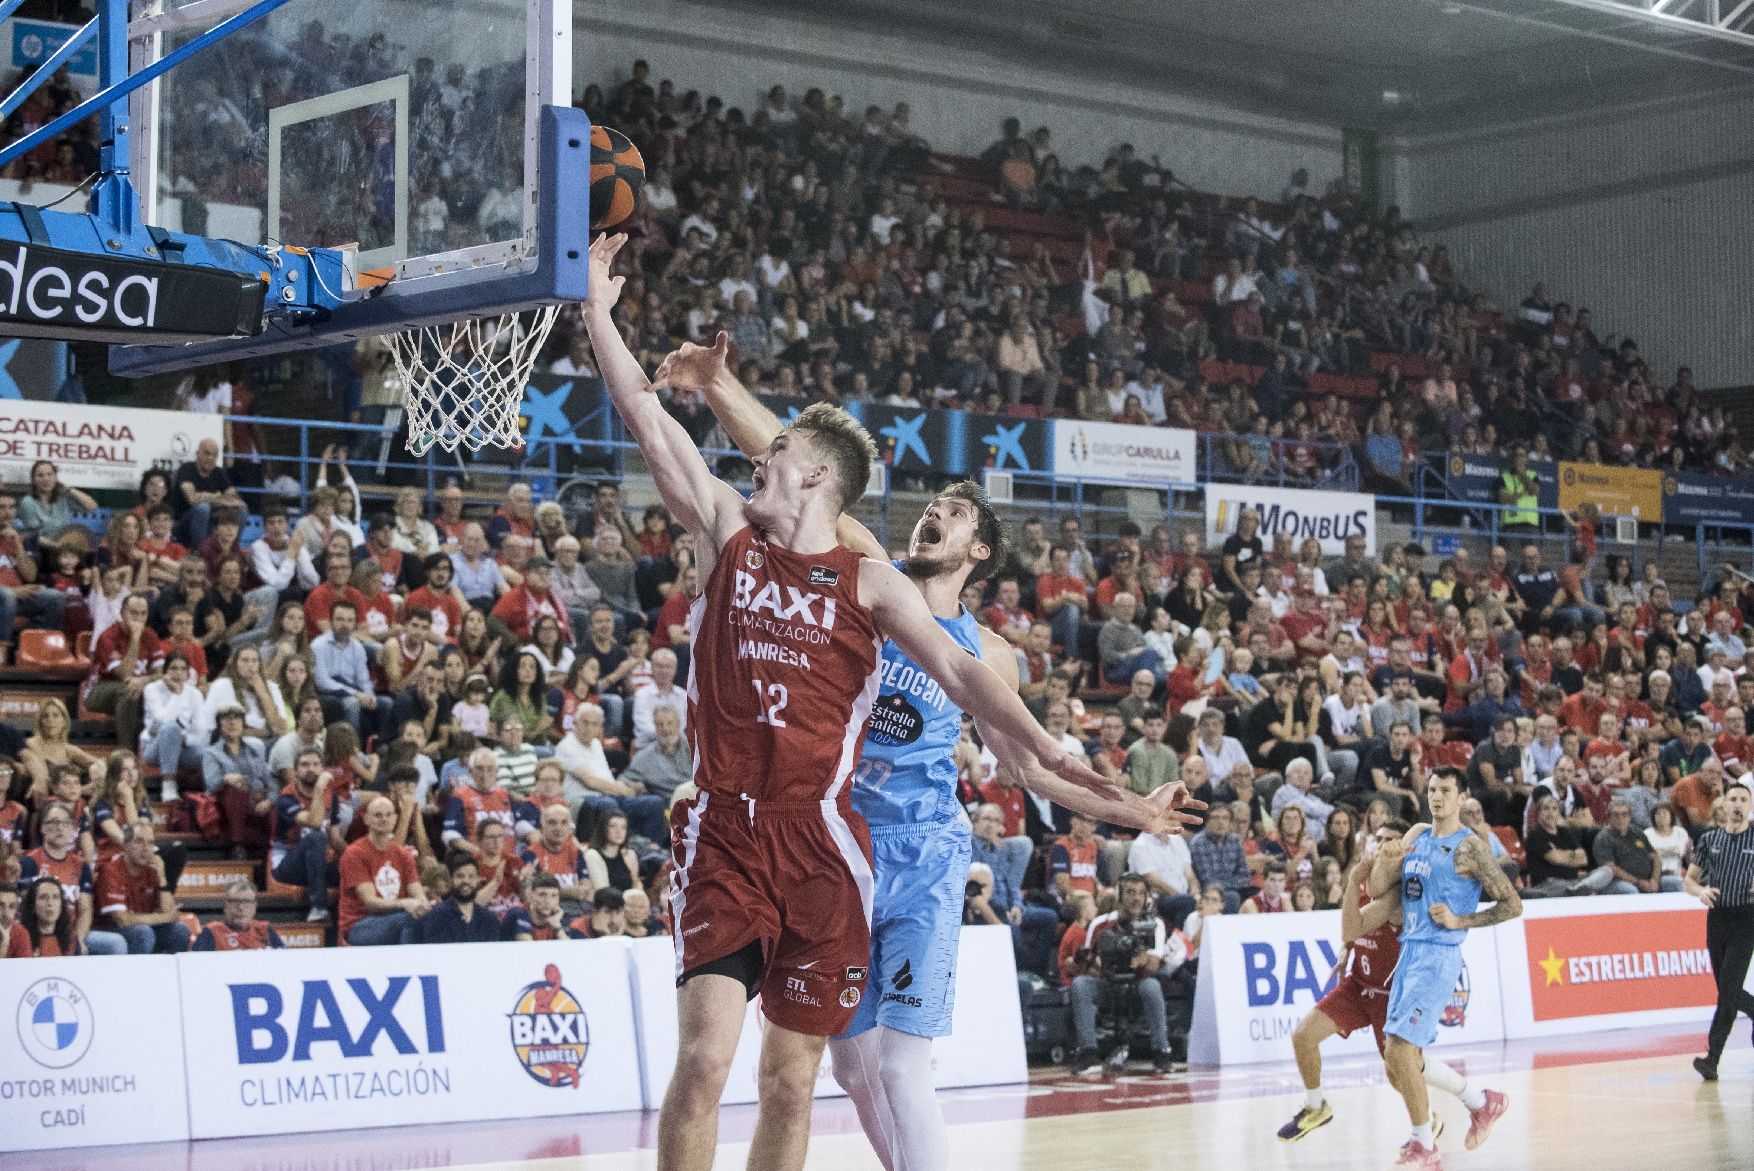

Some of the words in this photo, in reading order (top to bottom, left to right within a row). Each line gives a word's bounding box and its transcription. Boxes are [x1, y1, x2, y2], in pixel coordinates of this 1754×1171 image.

[0, 246, 158, 327] desa
[32, 441, 136, 464] TREBALL
[732, 568, 837, 631] BAXI
[738, 637, 811, 672] MANRESA
[752, 679, 788, 729] 12
[1360, 954, 1371, 976] 6
[1568, 952, 1656, 985] ESTRELLA
[26, 981, 82, 1008] BMW
[783, 990, 822, 1008] GLOBAL
[787, 976, 807, 993] ETL
[226, 974, 446, 1065] BAXI
[512, 1012, 588, 1047] BAXI
[0, 1079, 56, 1100] OTOR
[61, 1074, 137, 1097] MUNICH
[240, 1060, 452, 1108] CLIMATIZACIÓN
[40, 1103, 86, 1129] CADÍ
